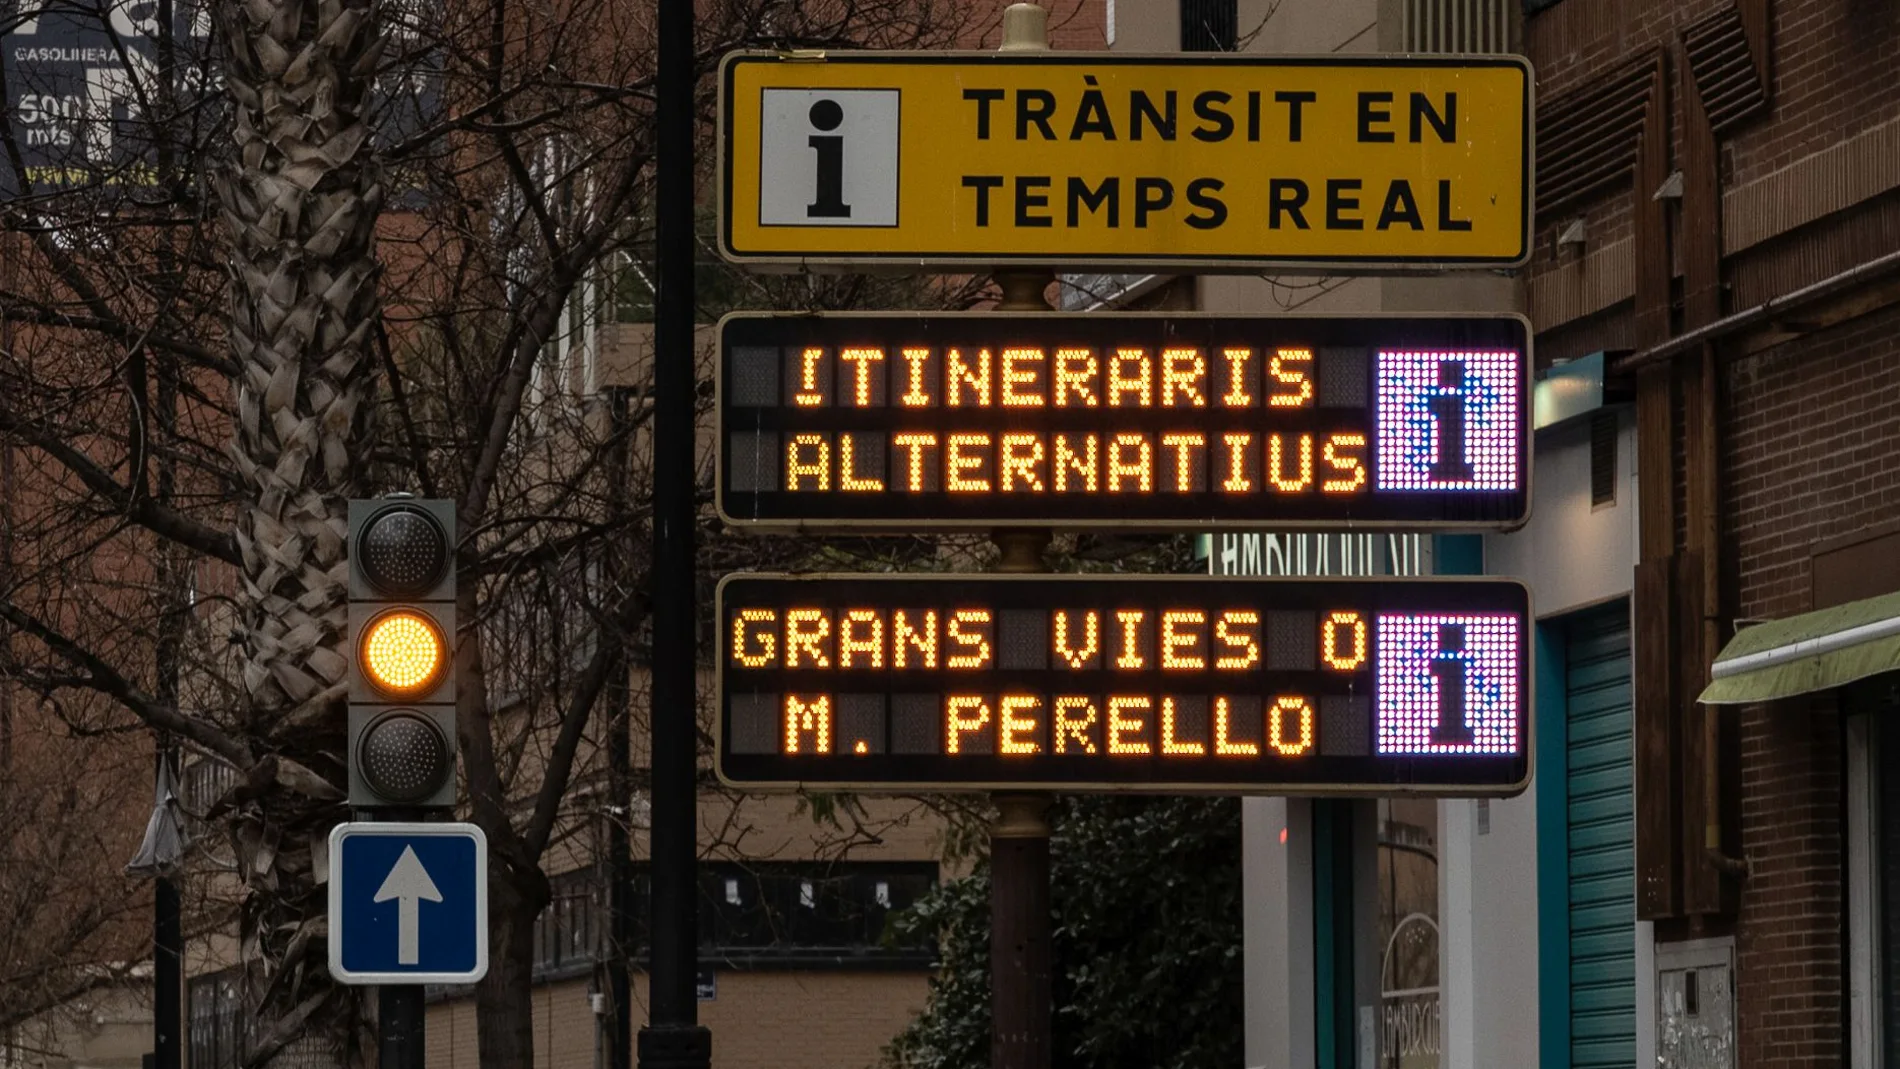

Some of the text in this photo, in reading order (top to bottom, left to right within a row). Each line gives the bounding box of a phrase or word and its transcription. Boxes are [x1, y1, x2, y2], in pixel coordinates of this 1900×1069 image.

[963, 75, 1456, 142] TRÀNSIT EN
[962, 176, 1472, 231] TEMPS REAL
[796, 347, 1312, 408] ITINERARIS
[788, 432, 1365, 493] ALTERNATIUS
[734, 609, 991, 669] GRANS
[1055, 610, 1258, 670] VIES
[785, 695, 1313, 756] M. PERELLO
